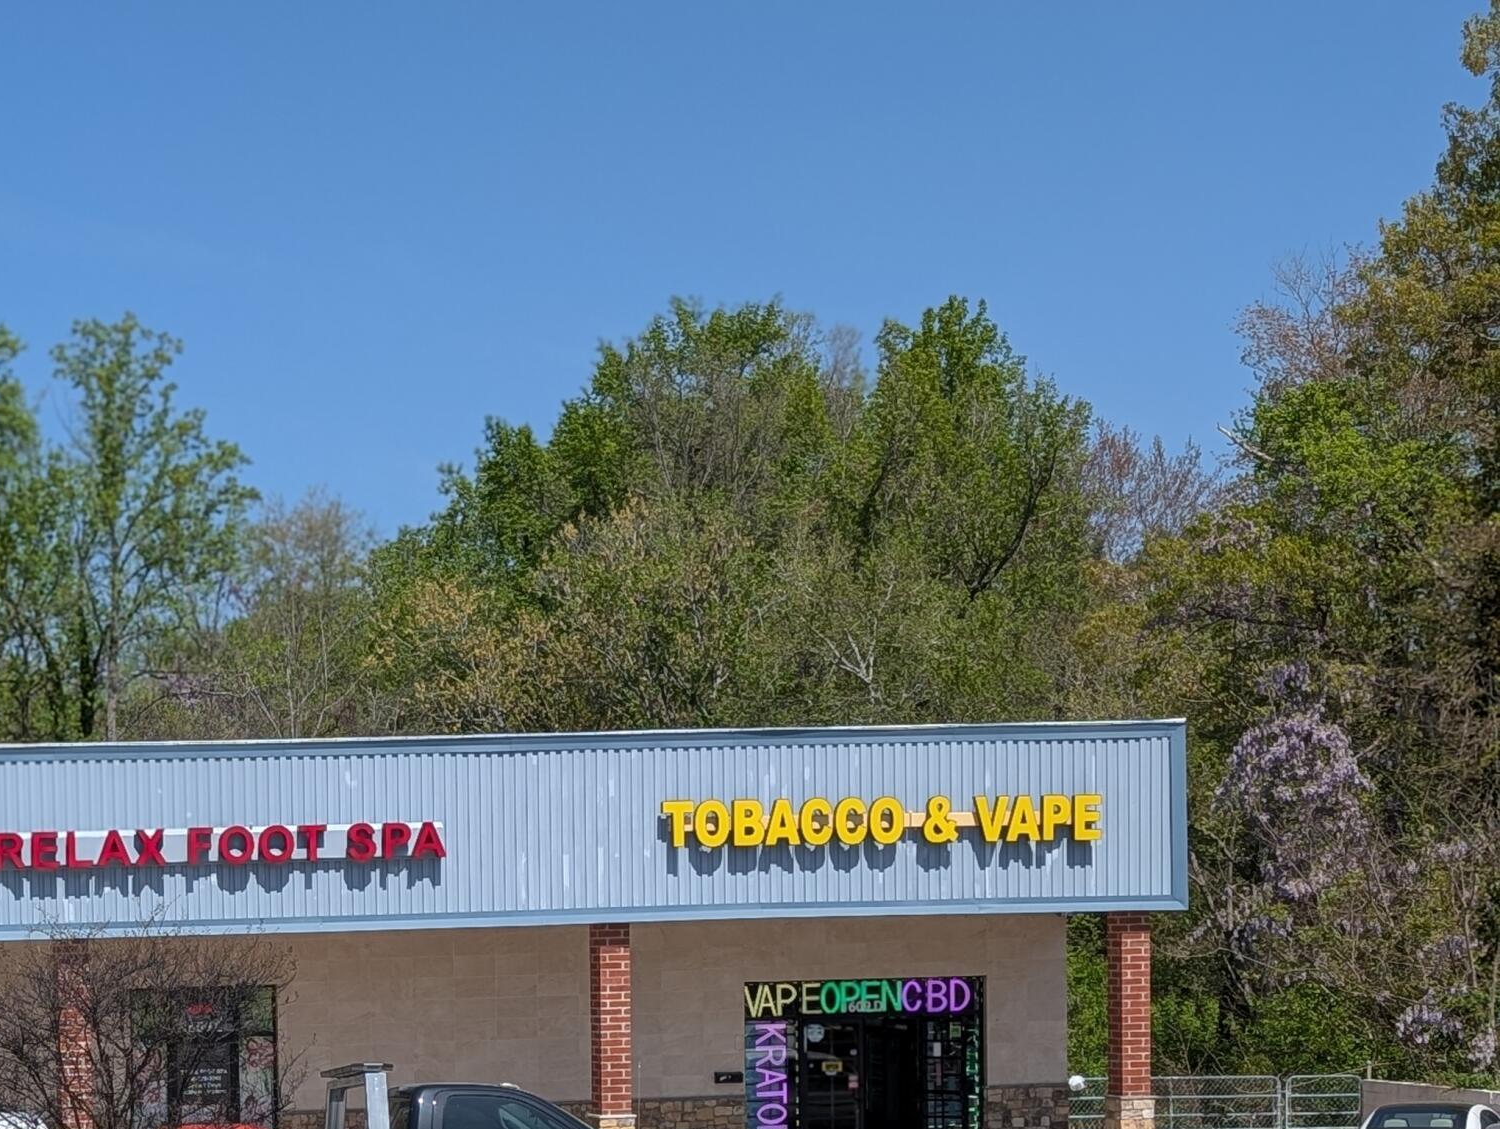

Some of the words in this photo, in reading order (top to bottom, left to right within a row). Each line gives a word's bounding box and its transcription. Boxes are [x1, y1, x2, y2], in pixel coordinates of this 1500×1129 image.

[186, 824, 328, 865] FOOT
[346, 820, 447, 862] SPA
[661, 798, 905, 848] TOBACCO
[921, 796, 959, 843] &
[972, 794, 1103, 843] VAPE
[744, 981, 823, 1018] VAPE
[820, 980, 902, 1014] OPEN
[902, 978, 971, 1014] CBD
